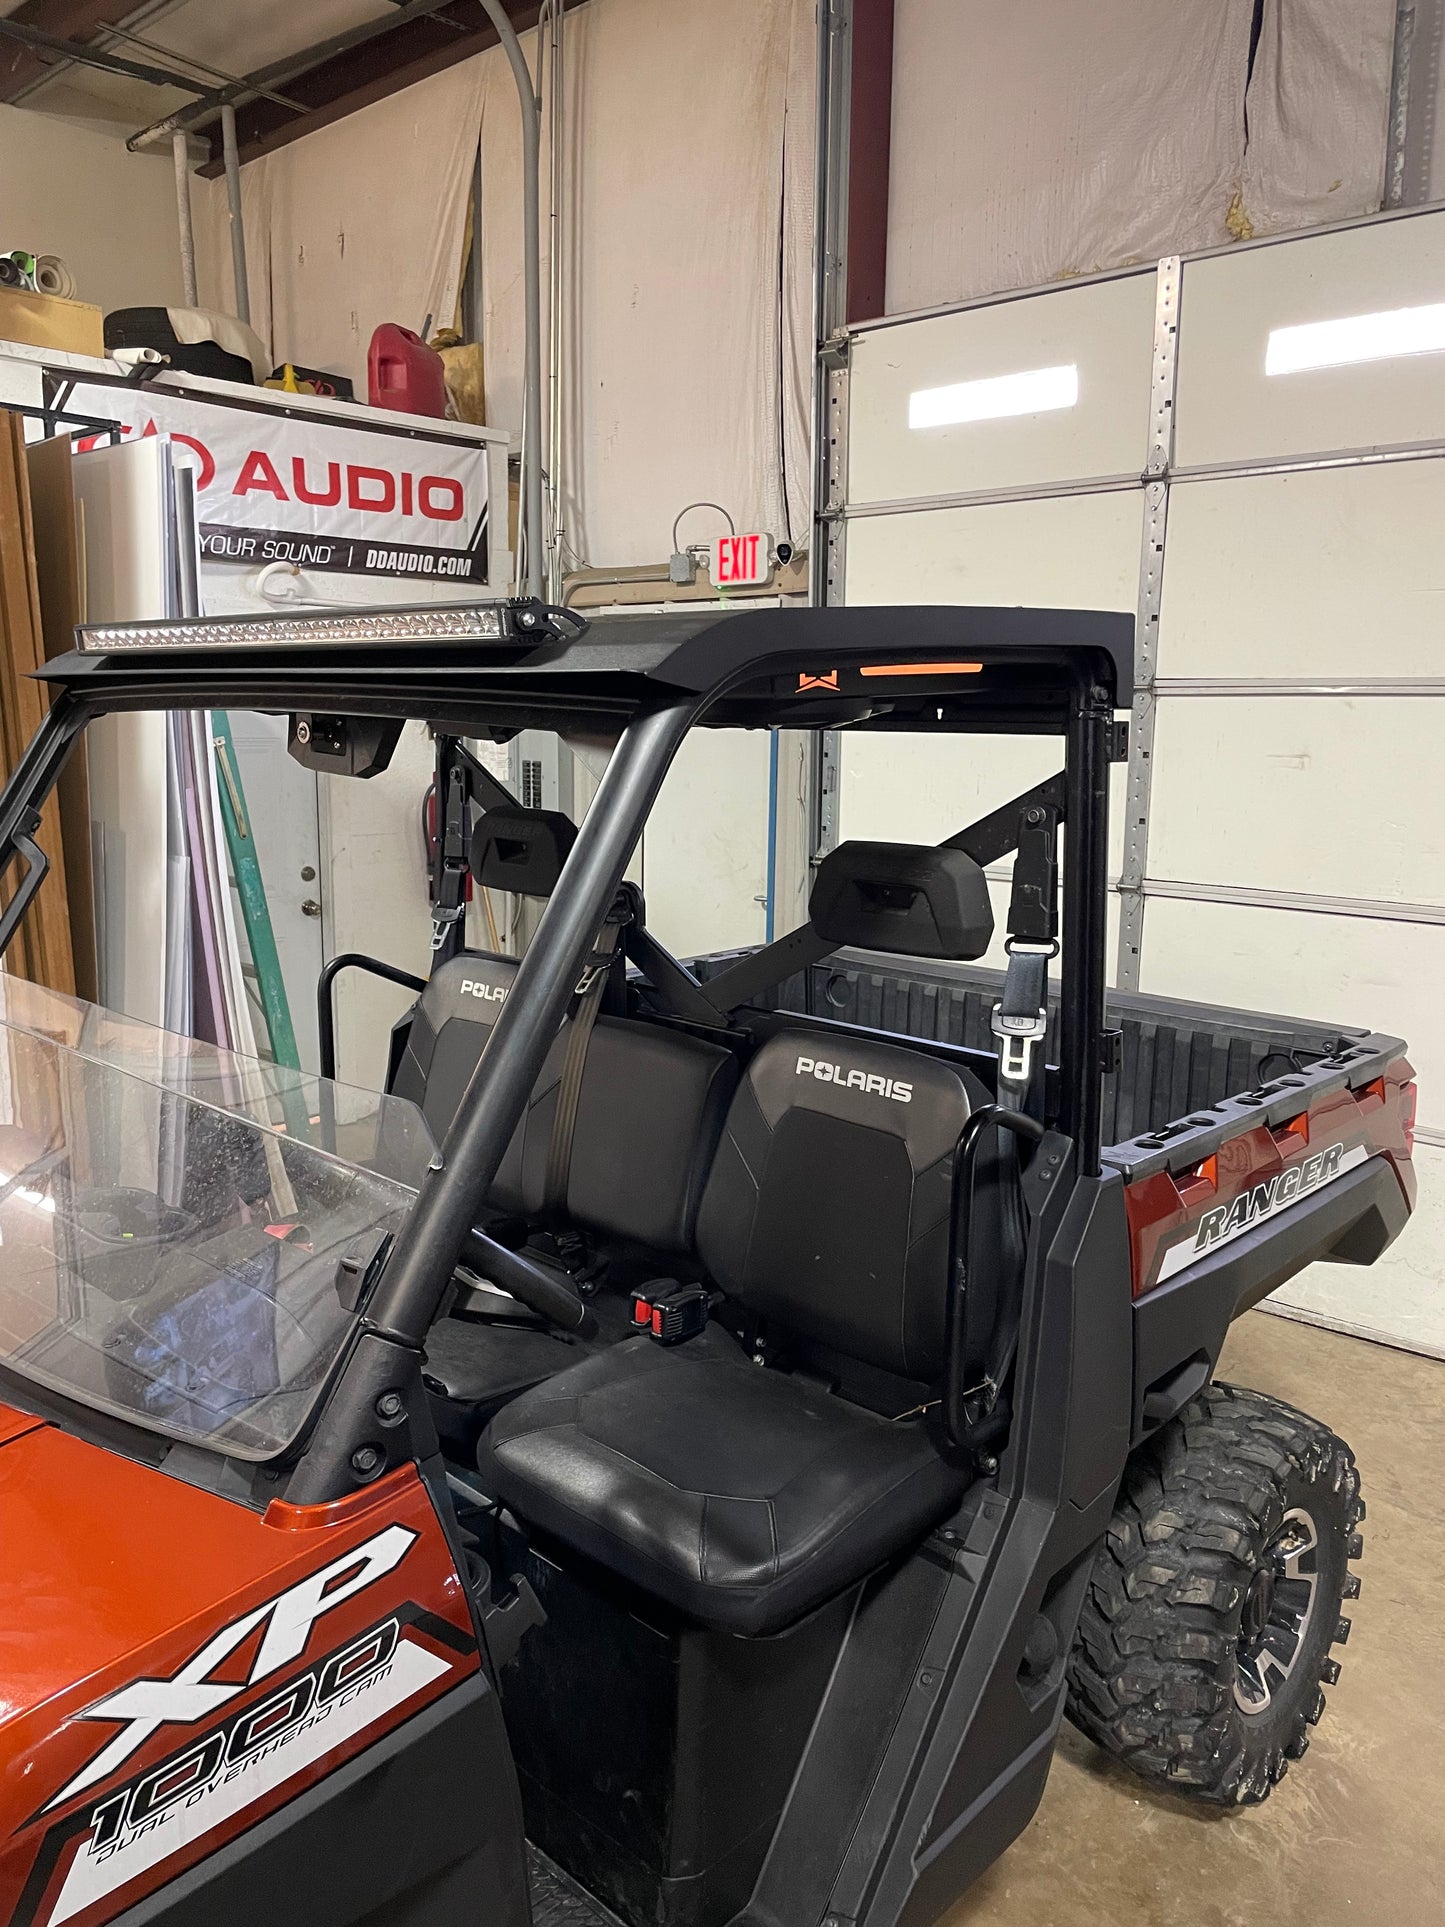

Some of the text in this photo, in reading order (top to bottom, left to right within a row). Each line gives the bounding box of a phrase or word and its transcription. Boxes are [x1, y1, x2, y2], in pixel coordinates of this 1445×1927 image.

[232, 450, 464, 522] AUDIO
[197, 535, 256, 558] YOUR
[366, 549, 472, 577] DDAUDIO.COM
[718, 535, 760, 582] EXIT
[795, 1056, 914, 1103] POLARIS
[1192, 1142, 1344, 1253] RANGER
[36, 1524, 420, 1818] XP
[87, 1616, 400, 1857] 1000
[95, 1664, 393, 1866] DUAL OVERHEAD CAM
